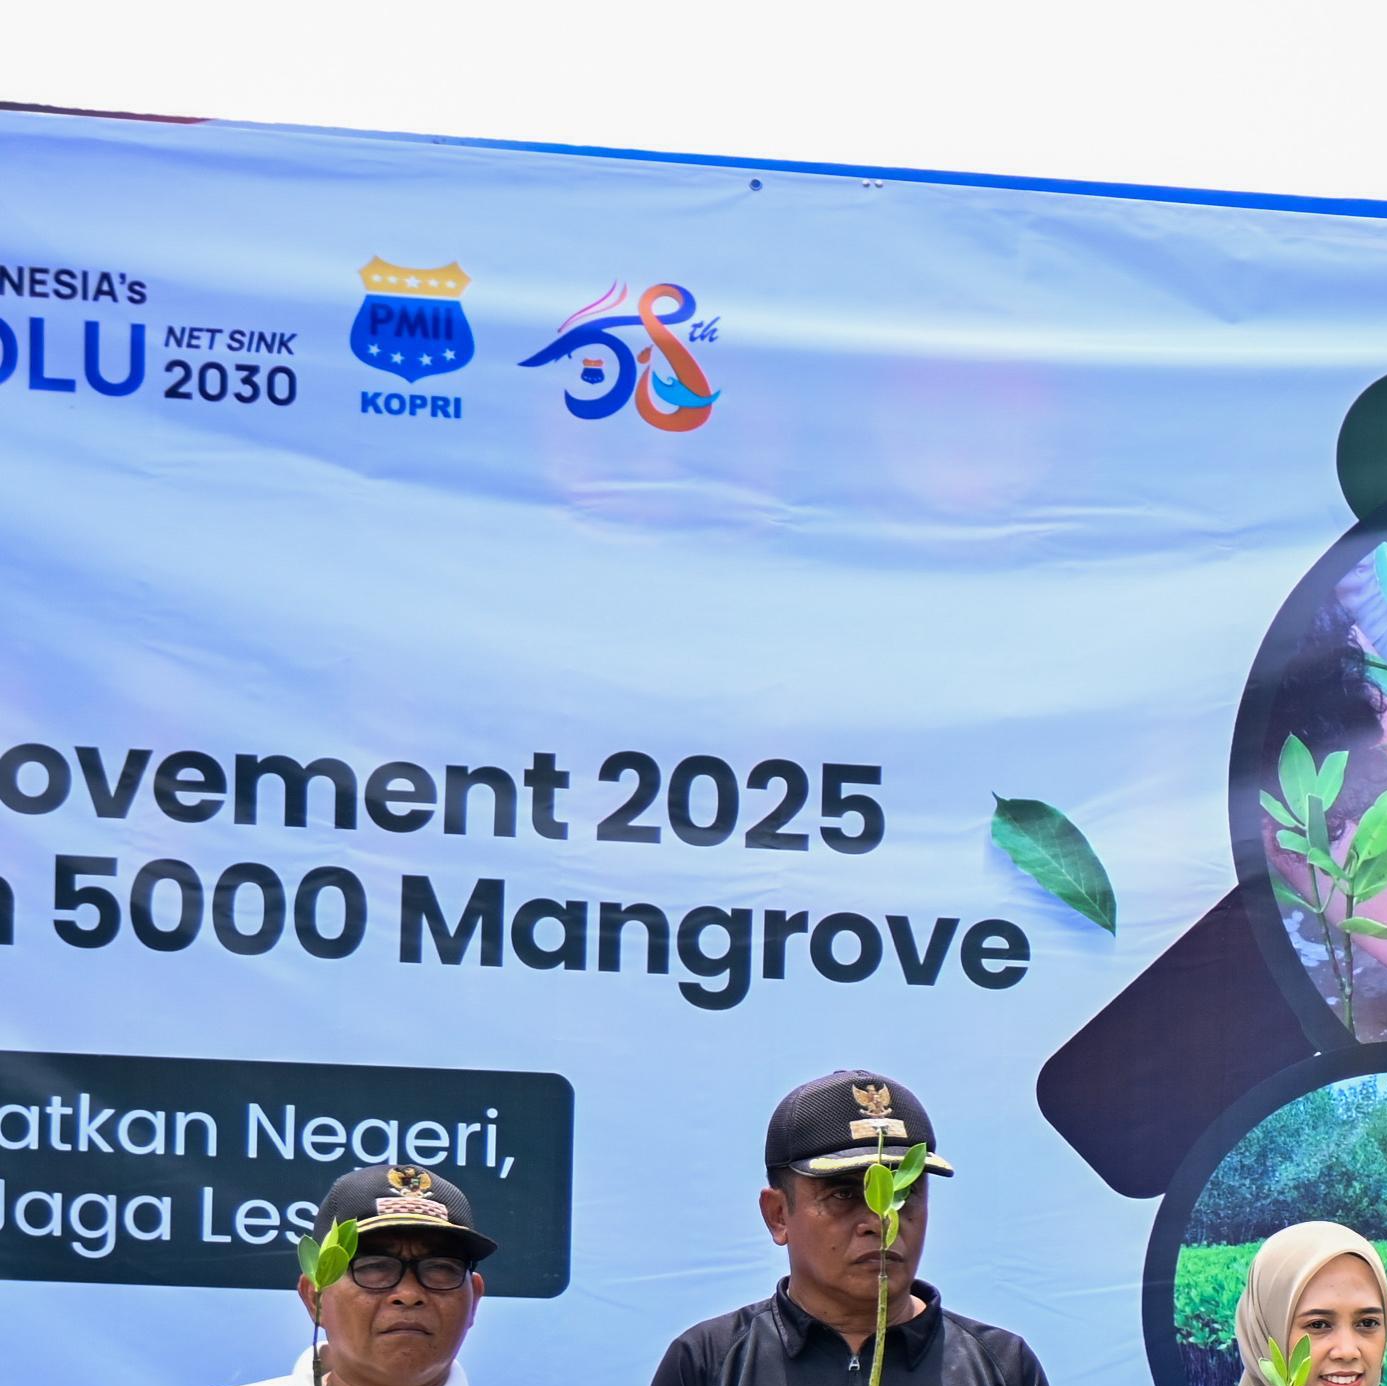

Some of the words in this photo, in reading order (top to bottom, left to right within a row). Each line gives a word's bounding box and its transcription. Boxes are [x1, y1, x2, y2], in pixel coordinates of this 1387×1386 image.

[164, 325, 223, 351] NET
[226, 329, 298, 355] SINK
[370, 303, 454, 341] PMII
[0, 315, 146, 397] LU
[164, 359, 297, 406] 2030
[360, 391, 462, 419] KOPRI
[0, 743, 570, 841] ovement
[597, 750, 885, 855] 2025
[53, 854, 368, 960] 5000
[399, 874, 1031, 1011] Mangrove
[0, 1093, 217, 1158] atkan
[247, 1102, 515, 1179] Negeri,
[202, 1186, 320, 1246] Les
